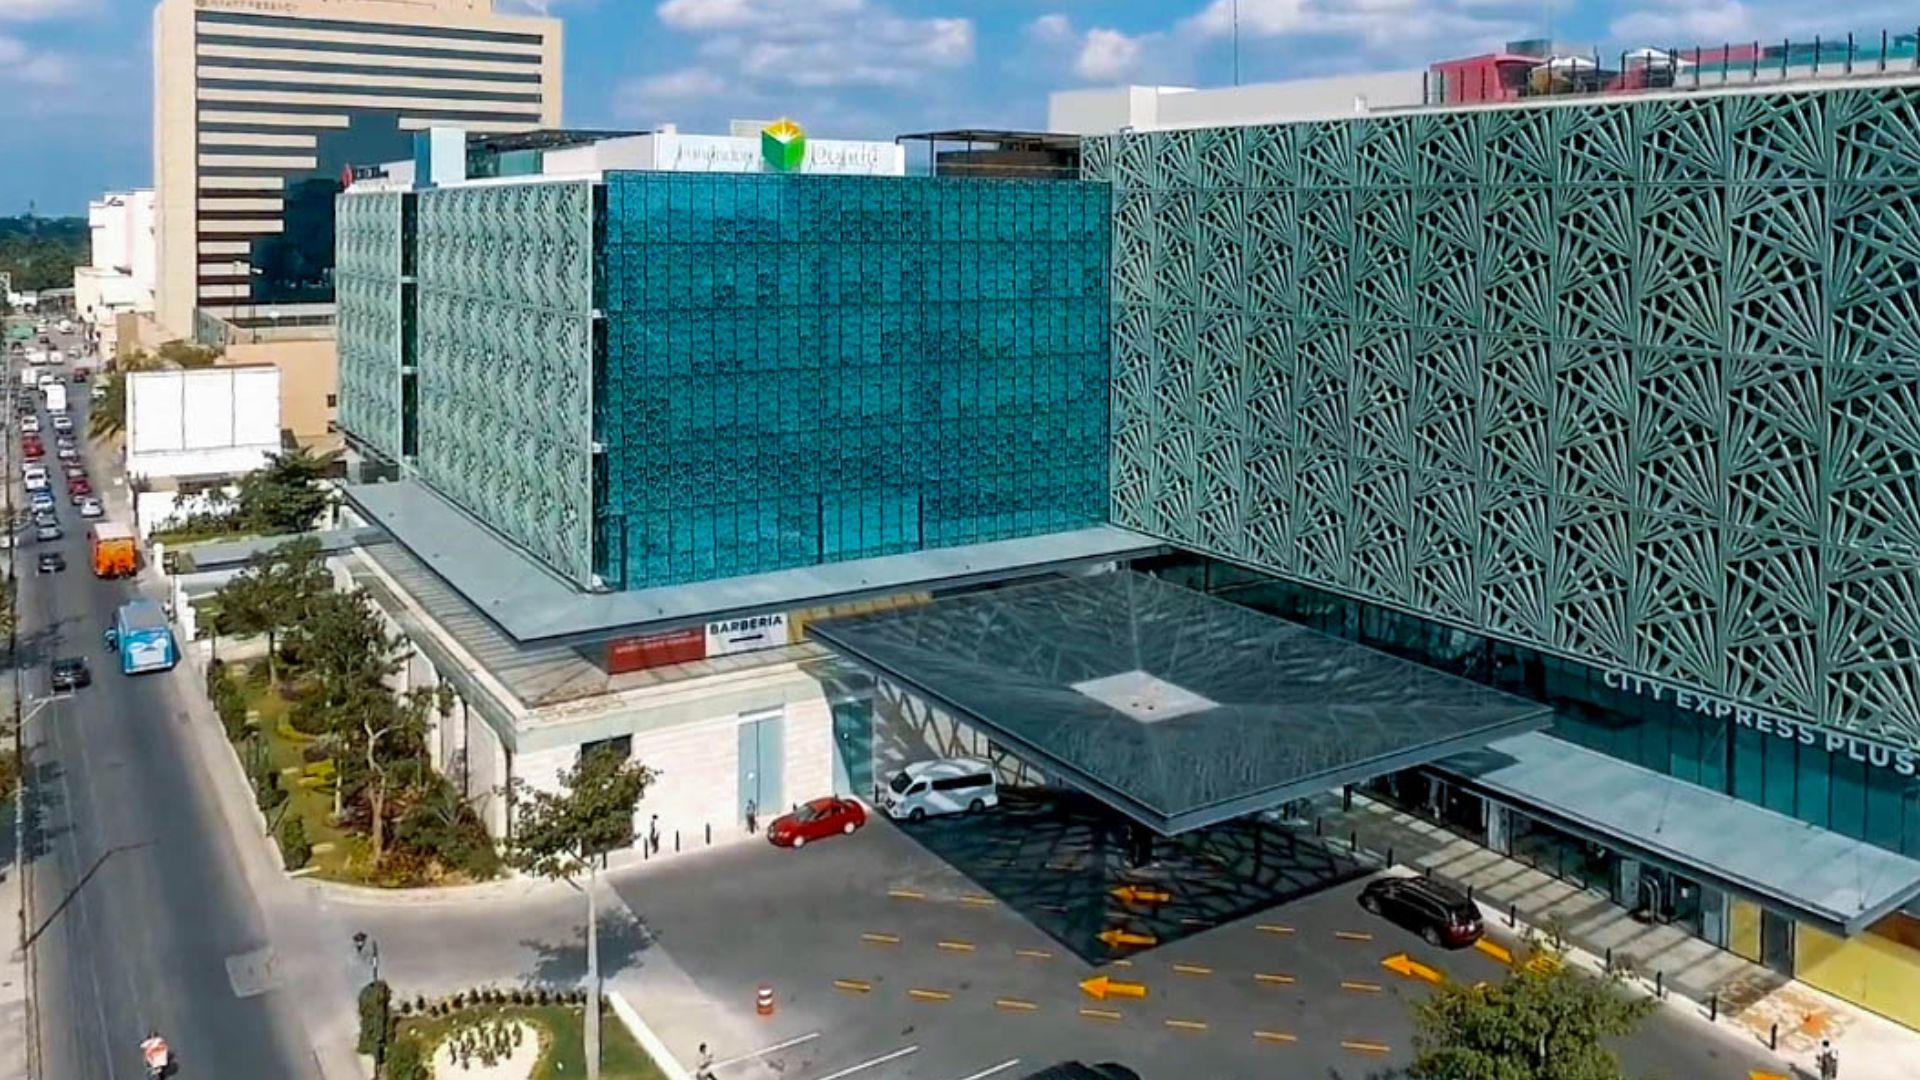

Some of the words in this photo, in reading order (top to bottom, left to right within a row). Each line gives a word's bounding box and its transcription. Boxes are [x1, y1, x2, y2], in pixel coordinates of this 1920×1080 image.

[1603, 670, 1664, 700] CITY
[1676, 690, 1815, 745] EXPRESS
[1825, 731, 1916, 775] PLUS
